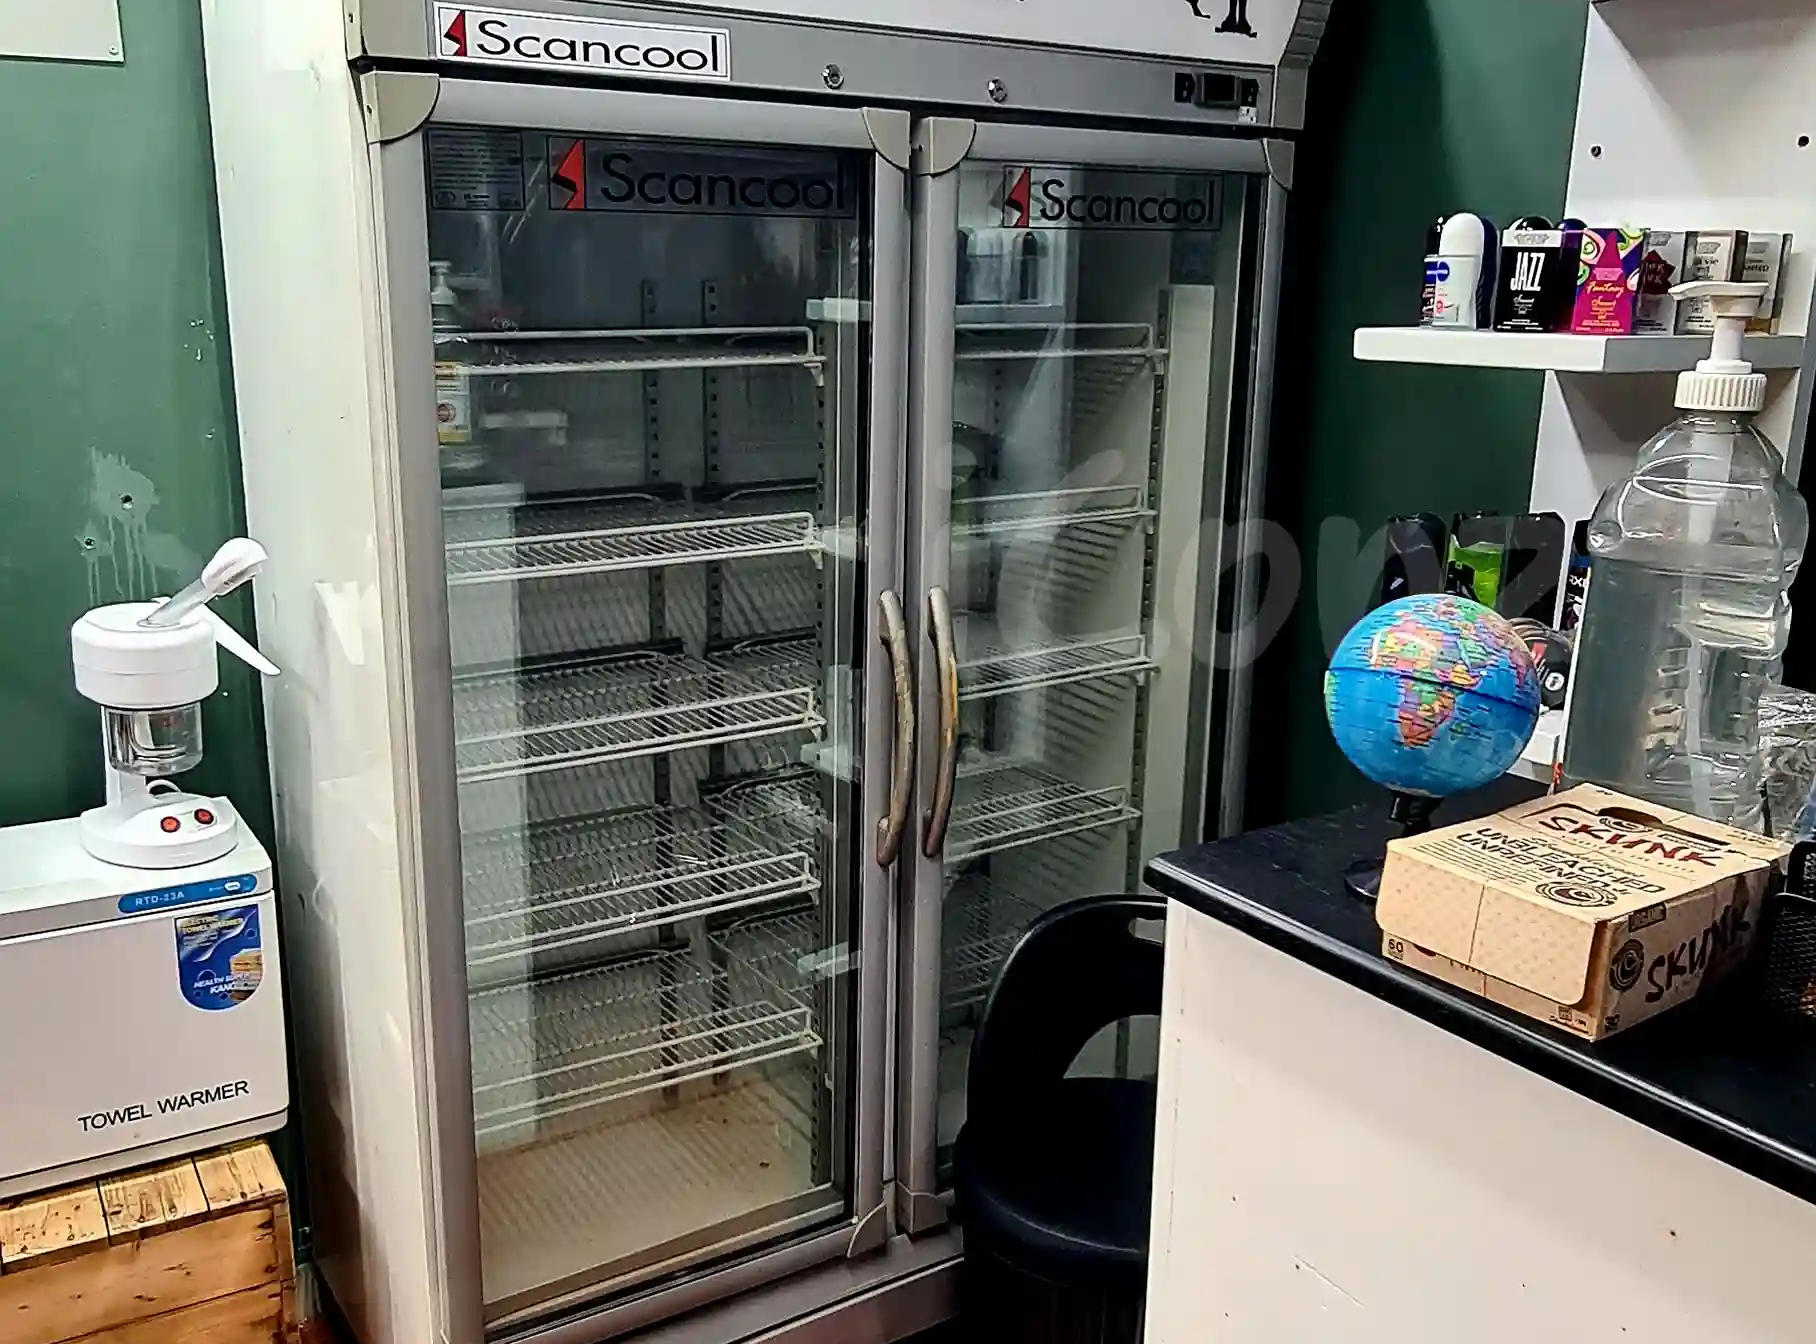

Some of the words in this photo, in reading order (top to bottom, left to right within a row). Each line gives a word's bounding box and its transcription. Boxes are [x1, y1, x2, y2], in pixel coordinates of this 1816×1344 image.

[477, 18, 720, 72] Scancool
[602, 154, 848, 211] Scancool
[1040, 179, 1216, 226] Scancool
[1510, 252, 1545, 291] JAZZ
[1476, 827, 1667, 894] UNBLEACHED
[1538, 816, 1722, 867] SKUNK
[1388, 938, 1404, 953] 60
[77, 1104, 153, 1132] TOWEL
[157, 1080, 250, 1114] WARMER
